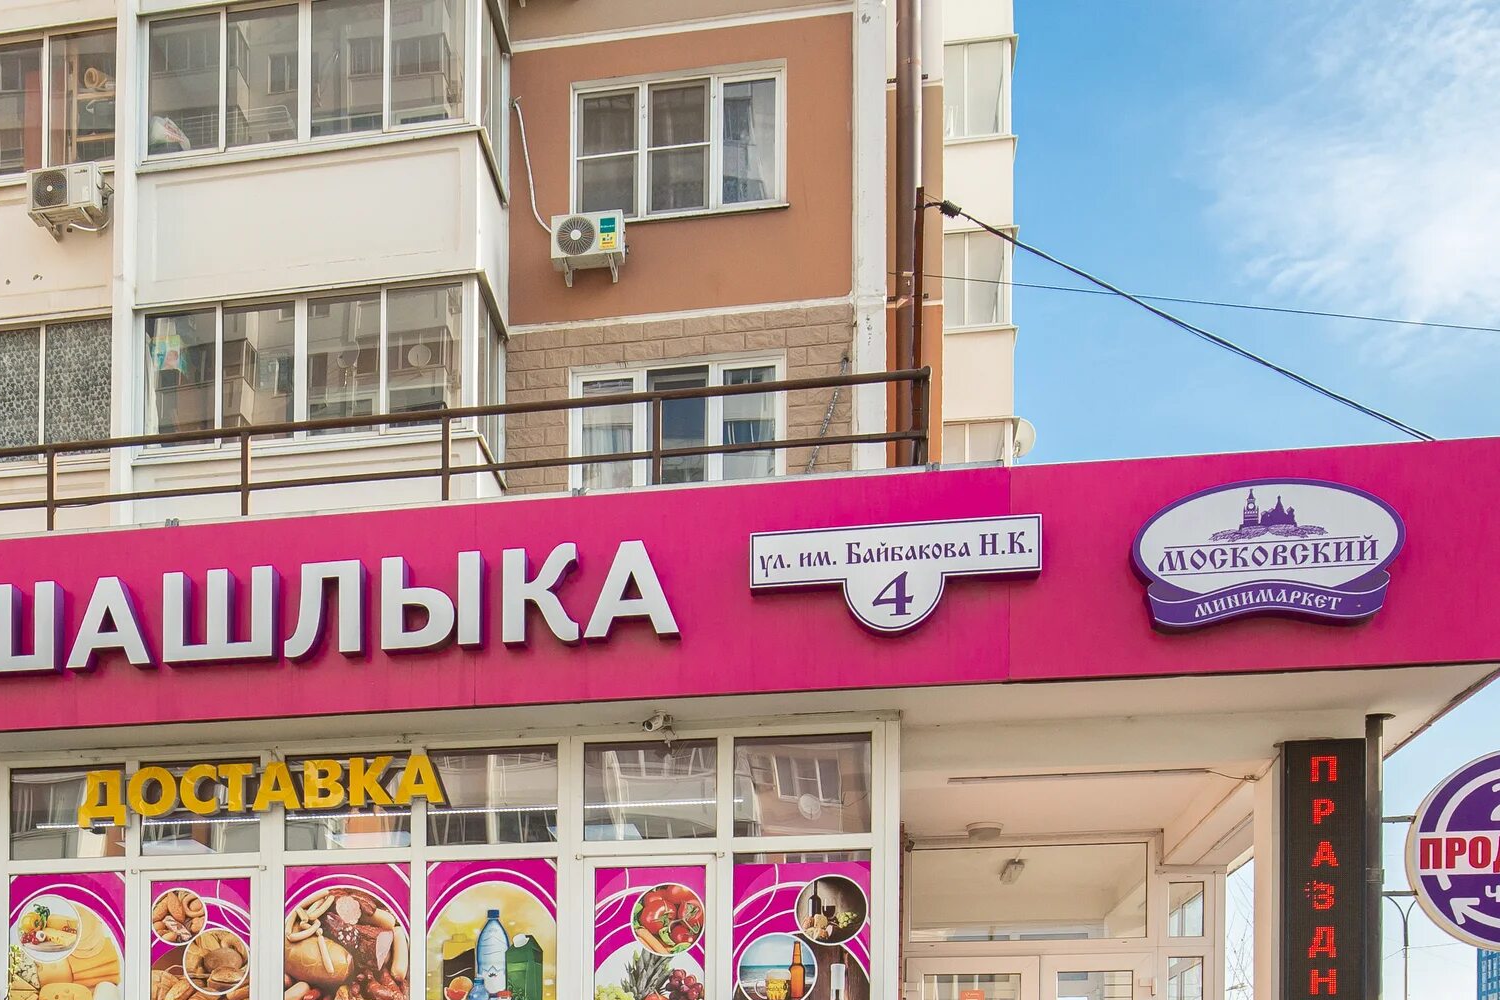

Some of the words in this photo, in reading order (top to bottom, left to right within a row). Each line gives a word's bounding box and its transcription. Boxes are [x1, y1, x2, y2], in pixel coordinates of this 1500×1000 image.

[760, 553, 791, 577] ул.
[799, 549, 837, 568] им.
[846, 541, 972, 565] Байбакова
[979, 531, 1033, 556] Н.К.
[1158, 534, 1379, 572] МОСКОВСКИЙ
[872, 571, 914, 616] 4
[1194, 588, 1342, 618] МИНИМАРКЕТ
[78, 754, 447, 828] ДОСТАВКА
[1419, 836, 1500, 874] ПРО
